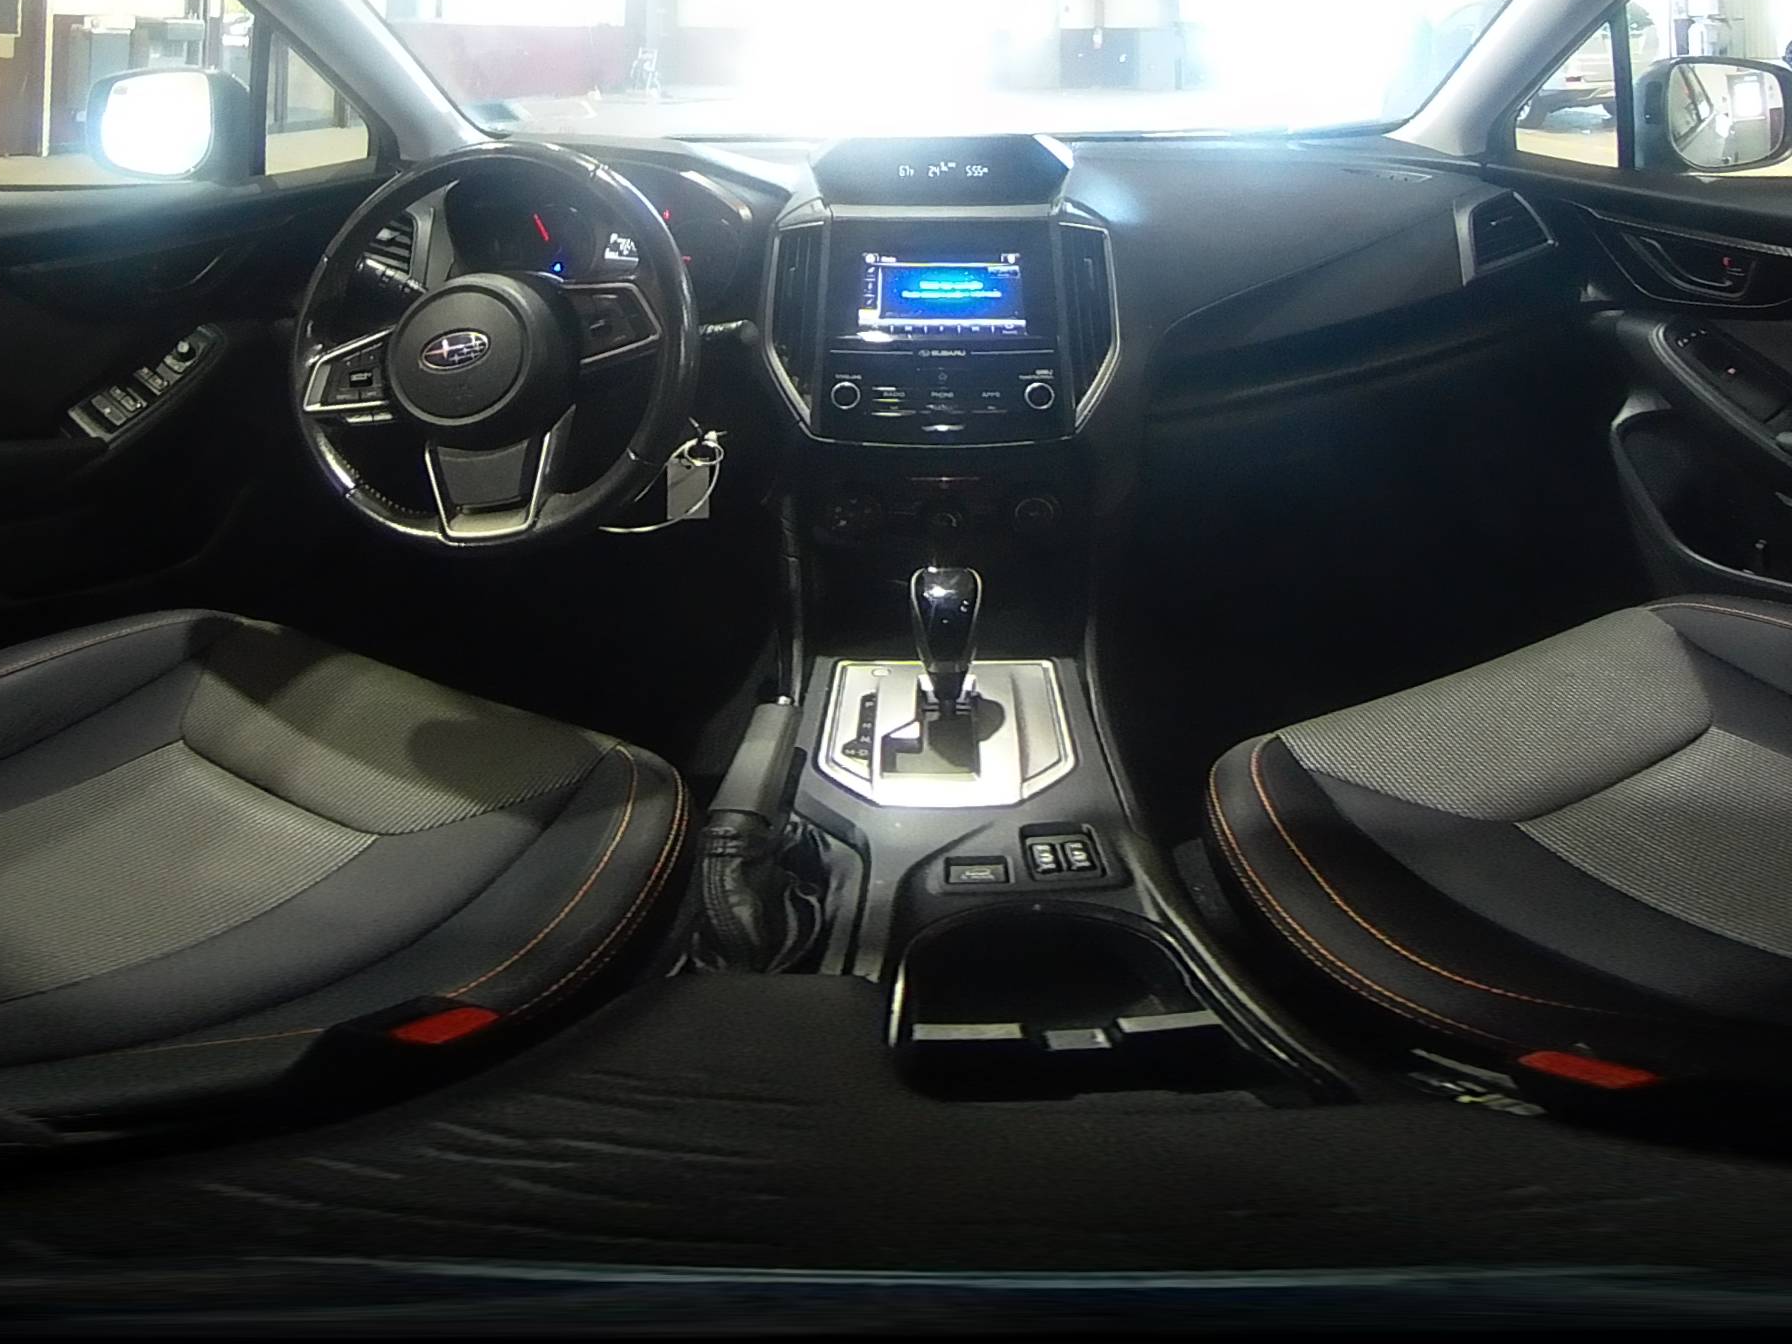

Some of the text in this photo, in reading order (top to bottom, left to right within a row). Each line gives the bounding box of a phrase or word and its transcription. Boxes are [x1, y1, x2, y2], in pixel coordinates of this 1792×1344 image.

[931, 349, 967, 357] SUBARU
[883, 390, 906, 398] RADIO
[930, 390, 954, 399] PHONE
